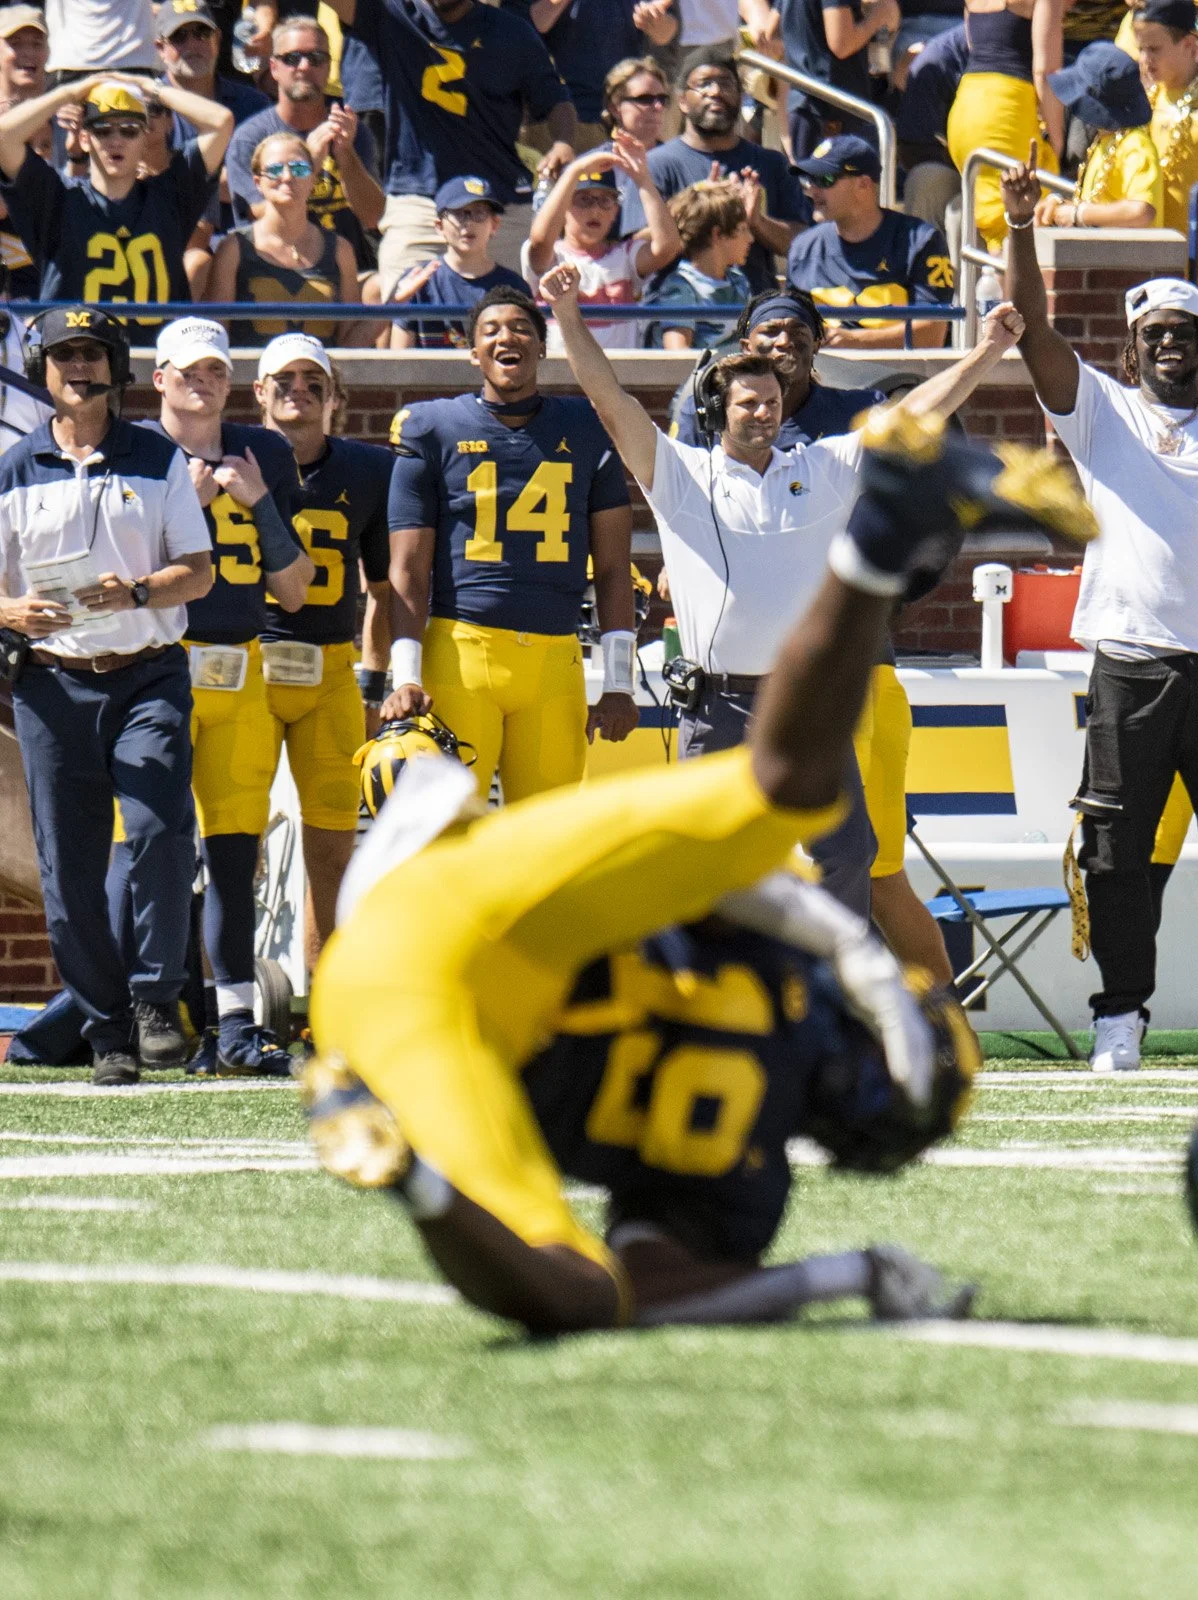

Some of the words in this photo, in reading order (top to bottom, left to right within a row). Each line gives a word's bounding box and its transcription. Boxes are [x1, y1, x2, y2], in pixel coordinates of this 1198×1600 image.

[65, 311, 91, 328] M
[83, 232, 170, 325] 20
[210, 492, 262, 586] 5
[465, 460, 573, 563] 14
